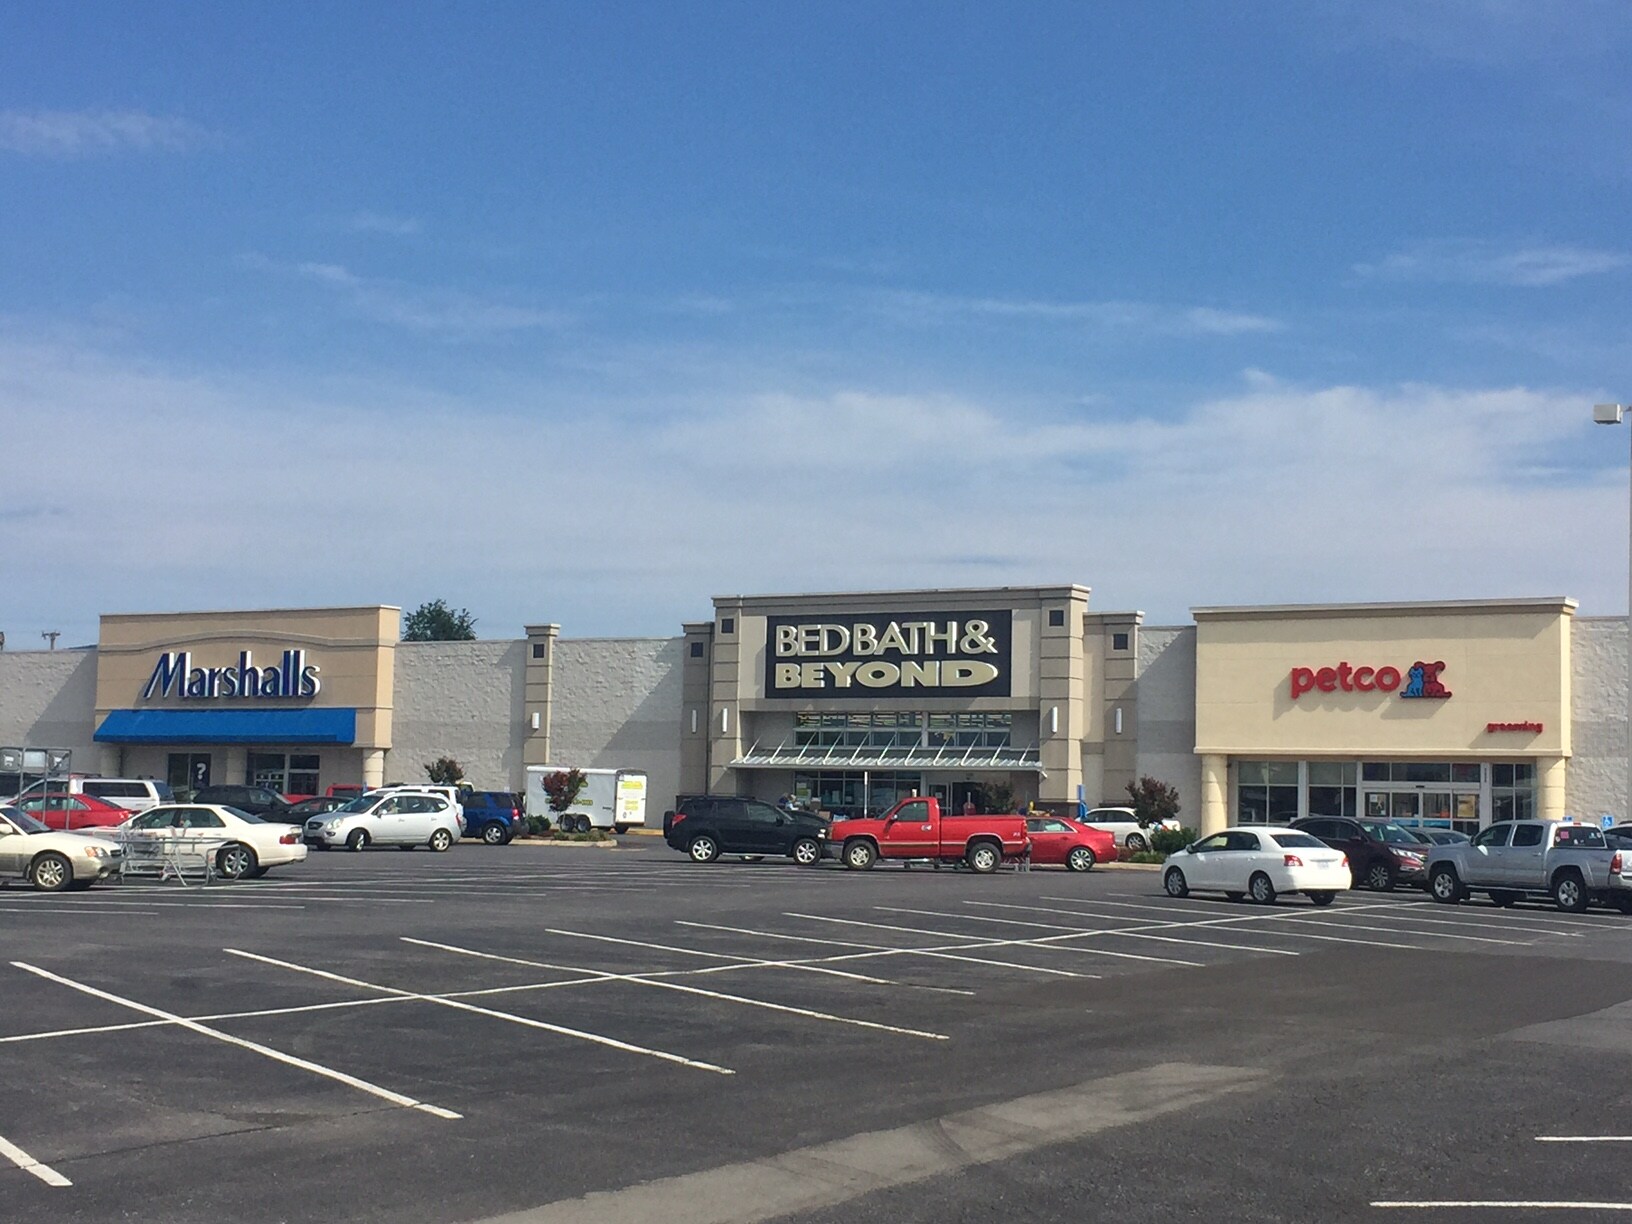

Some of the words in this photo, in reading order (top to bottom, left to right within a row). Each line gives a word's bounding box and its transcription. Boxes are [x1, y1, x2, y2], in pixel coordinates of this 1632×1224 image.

[776, 625, 850, 656] BED
[854, 621, 957, 655] BATH
[960, 620, 998, 654] &
[143, 650, 321, 697] Marshalls
[775, 660, 998, 688] BEYOND
[1291, 662, 1401, 700] petco
